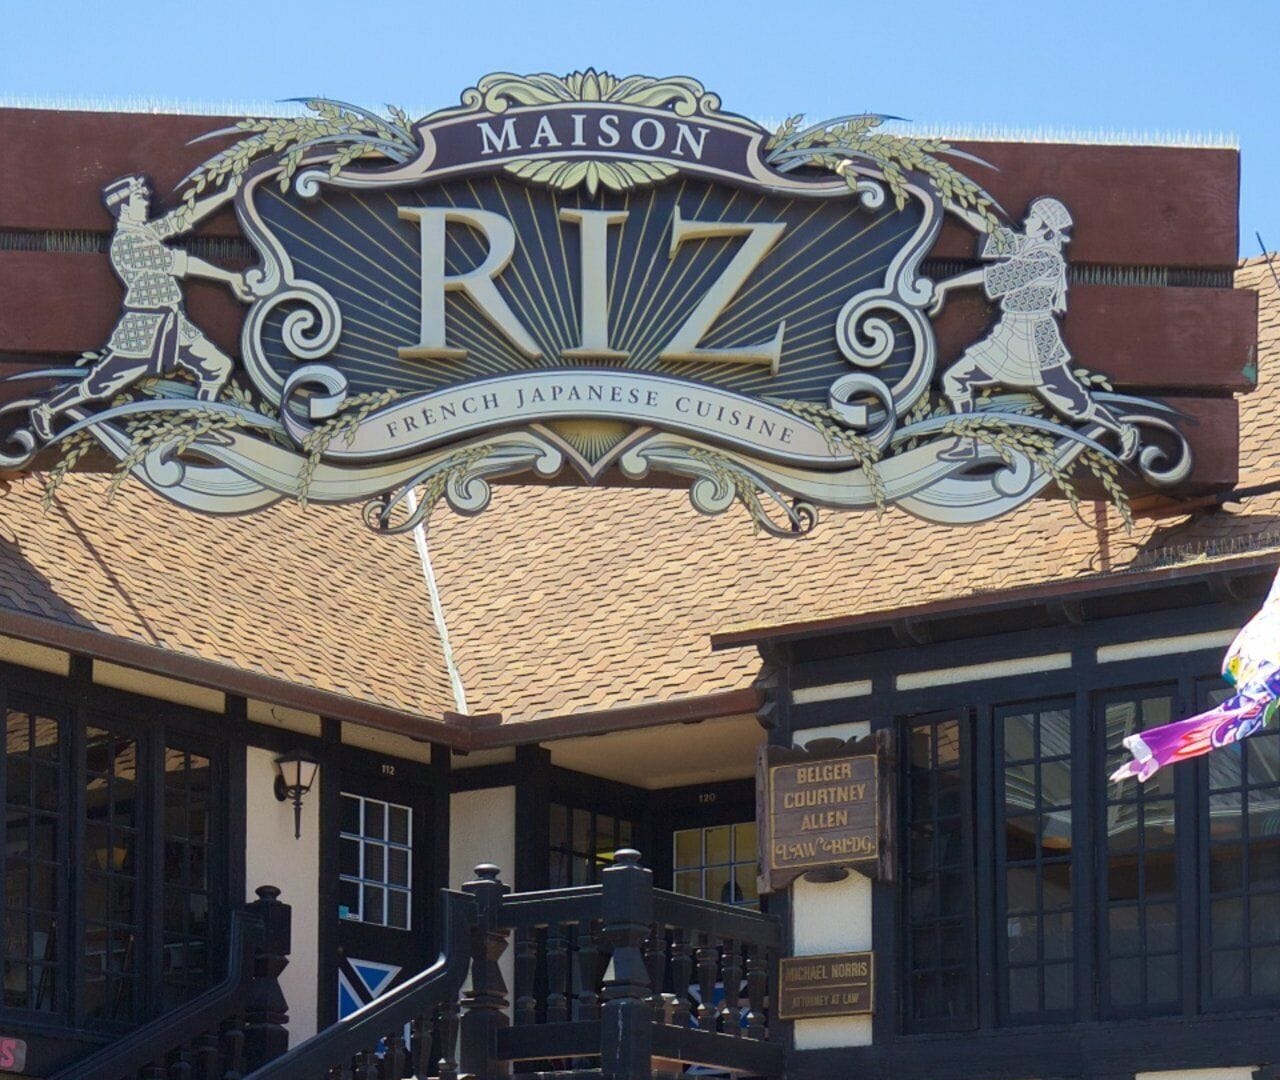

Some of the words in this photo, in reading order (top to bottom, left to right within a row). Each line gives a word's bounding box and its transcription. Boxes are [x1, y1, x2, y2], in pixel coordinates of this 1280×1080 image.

[477, 114, 711, 160] MAISON
[397, 205, 788, 377] RIZ
[385, 392, 500, 438] FRENCH
[517, 384, 659, 409] JAPANESE
[675, 397, 795, 444] CUISINE
[382, 765, 395, 775] 112
[797, 763, 852, 784] BELGER
[784, 783, 866, 809] COURTNEY
[801, 810, 848, 830] ALLEN
[776, 838, 823, 860] LAW
[786, 965, 828, 980] MICHAEL
[831, 962, 868, 978] NORRIS
[831, 993, 841, 1005] AT
[843, 993, 860, 1005] LAW
